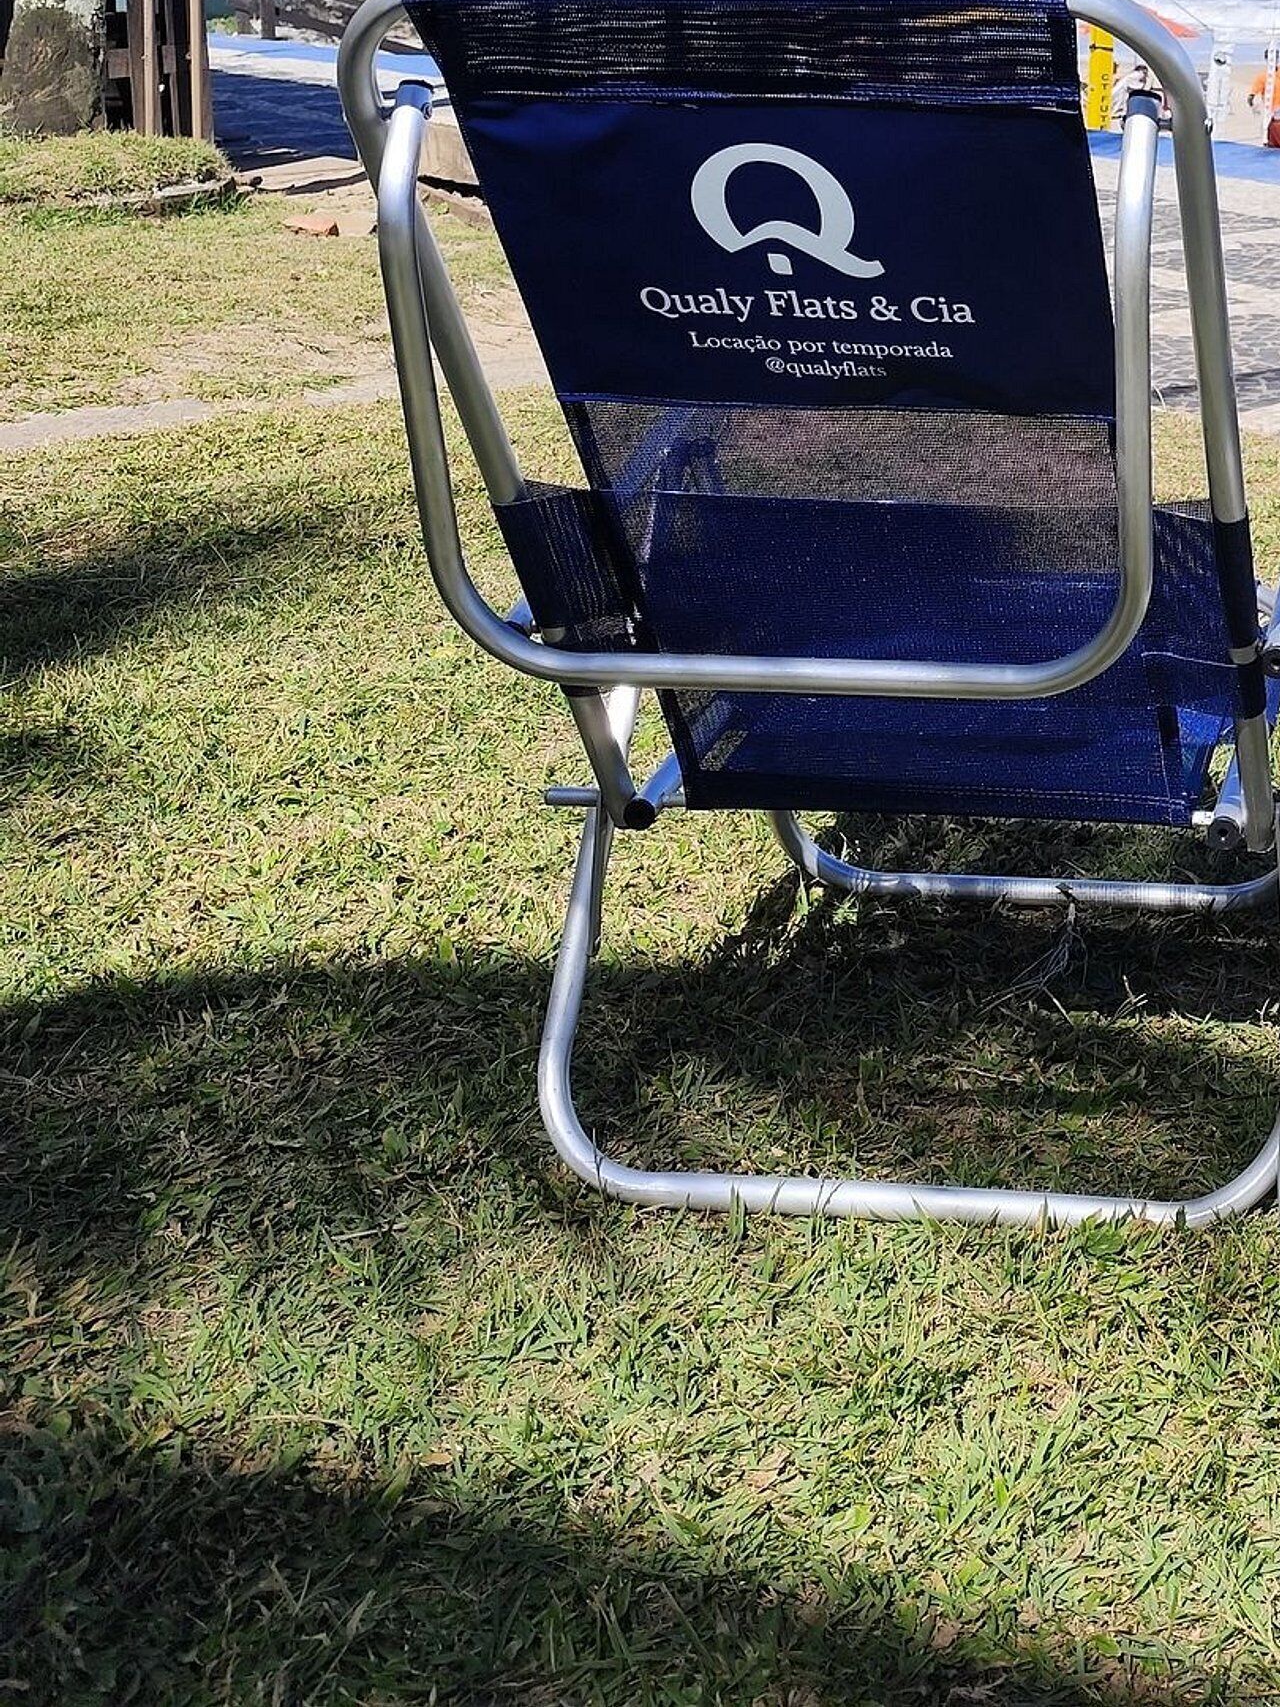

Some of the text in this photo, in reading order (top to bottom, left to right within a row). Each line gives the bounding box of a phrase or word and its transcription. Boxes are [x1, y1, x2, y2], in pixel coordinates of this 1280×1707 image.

[639, 286, 976, 324] Qualy Flats & Cia
[687, 330, 954, 360] Locação por temporada
[764, 356, 888, 380] @qualyflats
